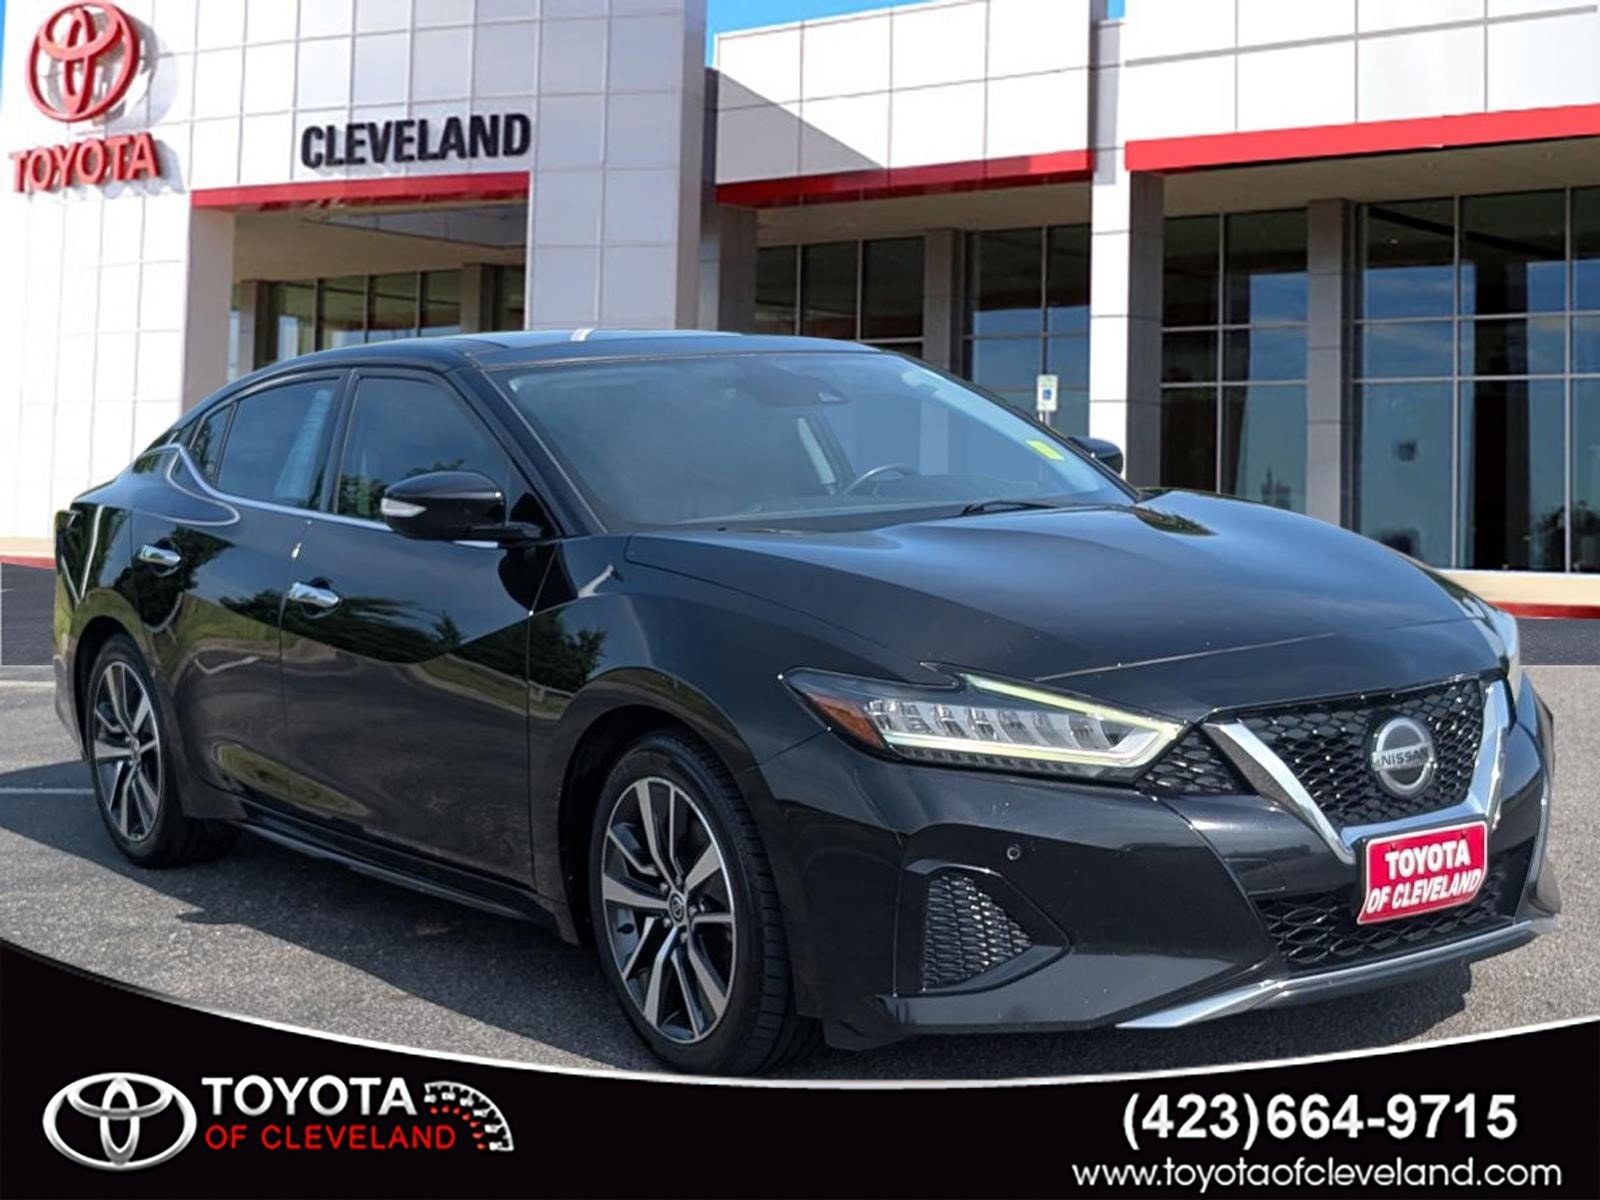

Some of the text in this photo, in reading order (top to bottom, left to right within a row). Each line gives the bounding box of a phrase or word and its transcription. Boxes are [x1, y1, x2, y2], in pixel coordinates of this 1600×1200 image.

[9, 132, 160, 193] TOYOTA
[301, 113, 531, 169] CLEVELAND
[1381, 747, 1429, 766] NISSAN
[1385, 839, 1471, 880] TOYOTA
[1367, 869, 1482, 913] OF CLEVELAND
